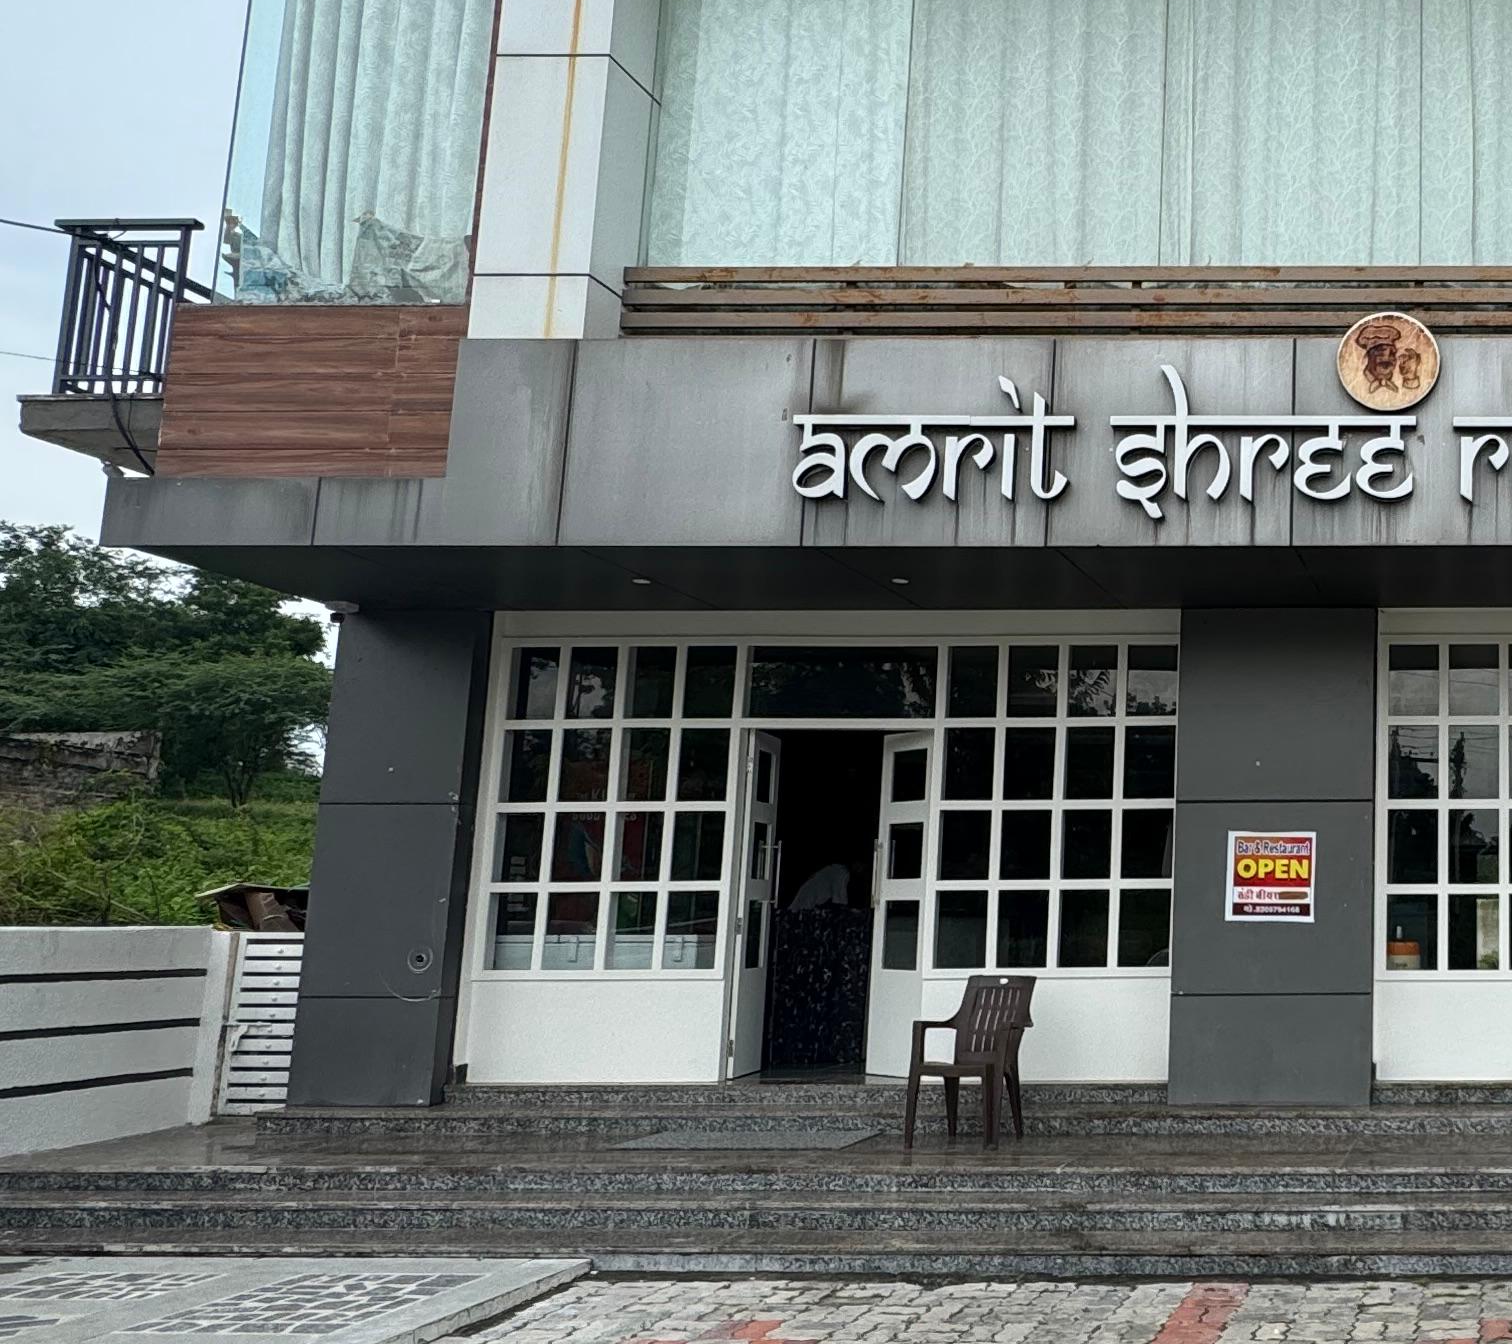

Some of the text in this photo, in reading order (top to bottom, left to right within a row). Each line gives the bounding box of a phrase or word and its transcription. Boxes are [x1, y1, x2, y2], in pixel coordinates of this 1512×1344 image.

[791, 375, 1076, 503] amrit
[1109, 364, 1417, 520] shree
[1263, 840, 1310, 856] Restaurant
[1237, 858, 1310, 879] OPEN
